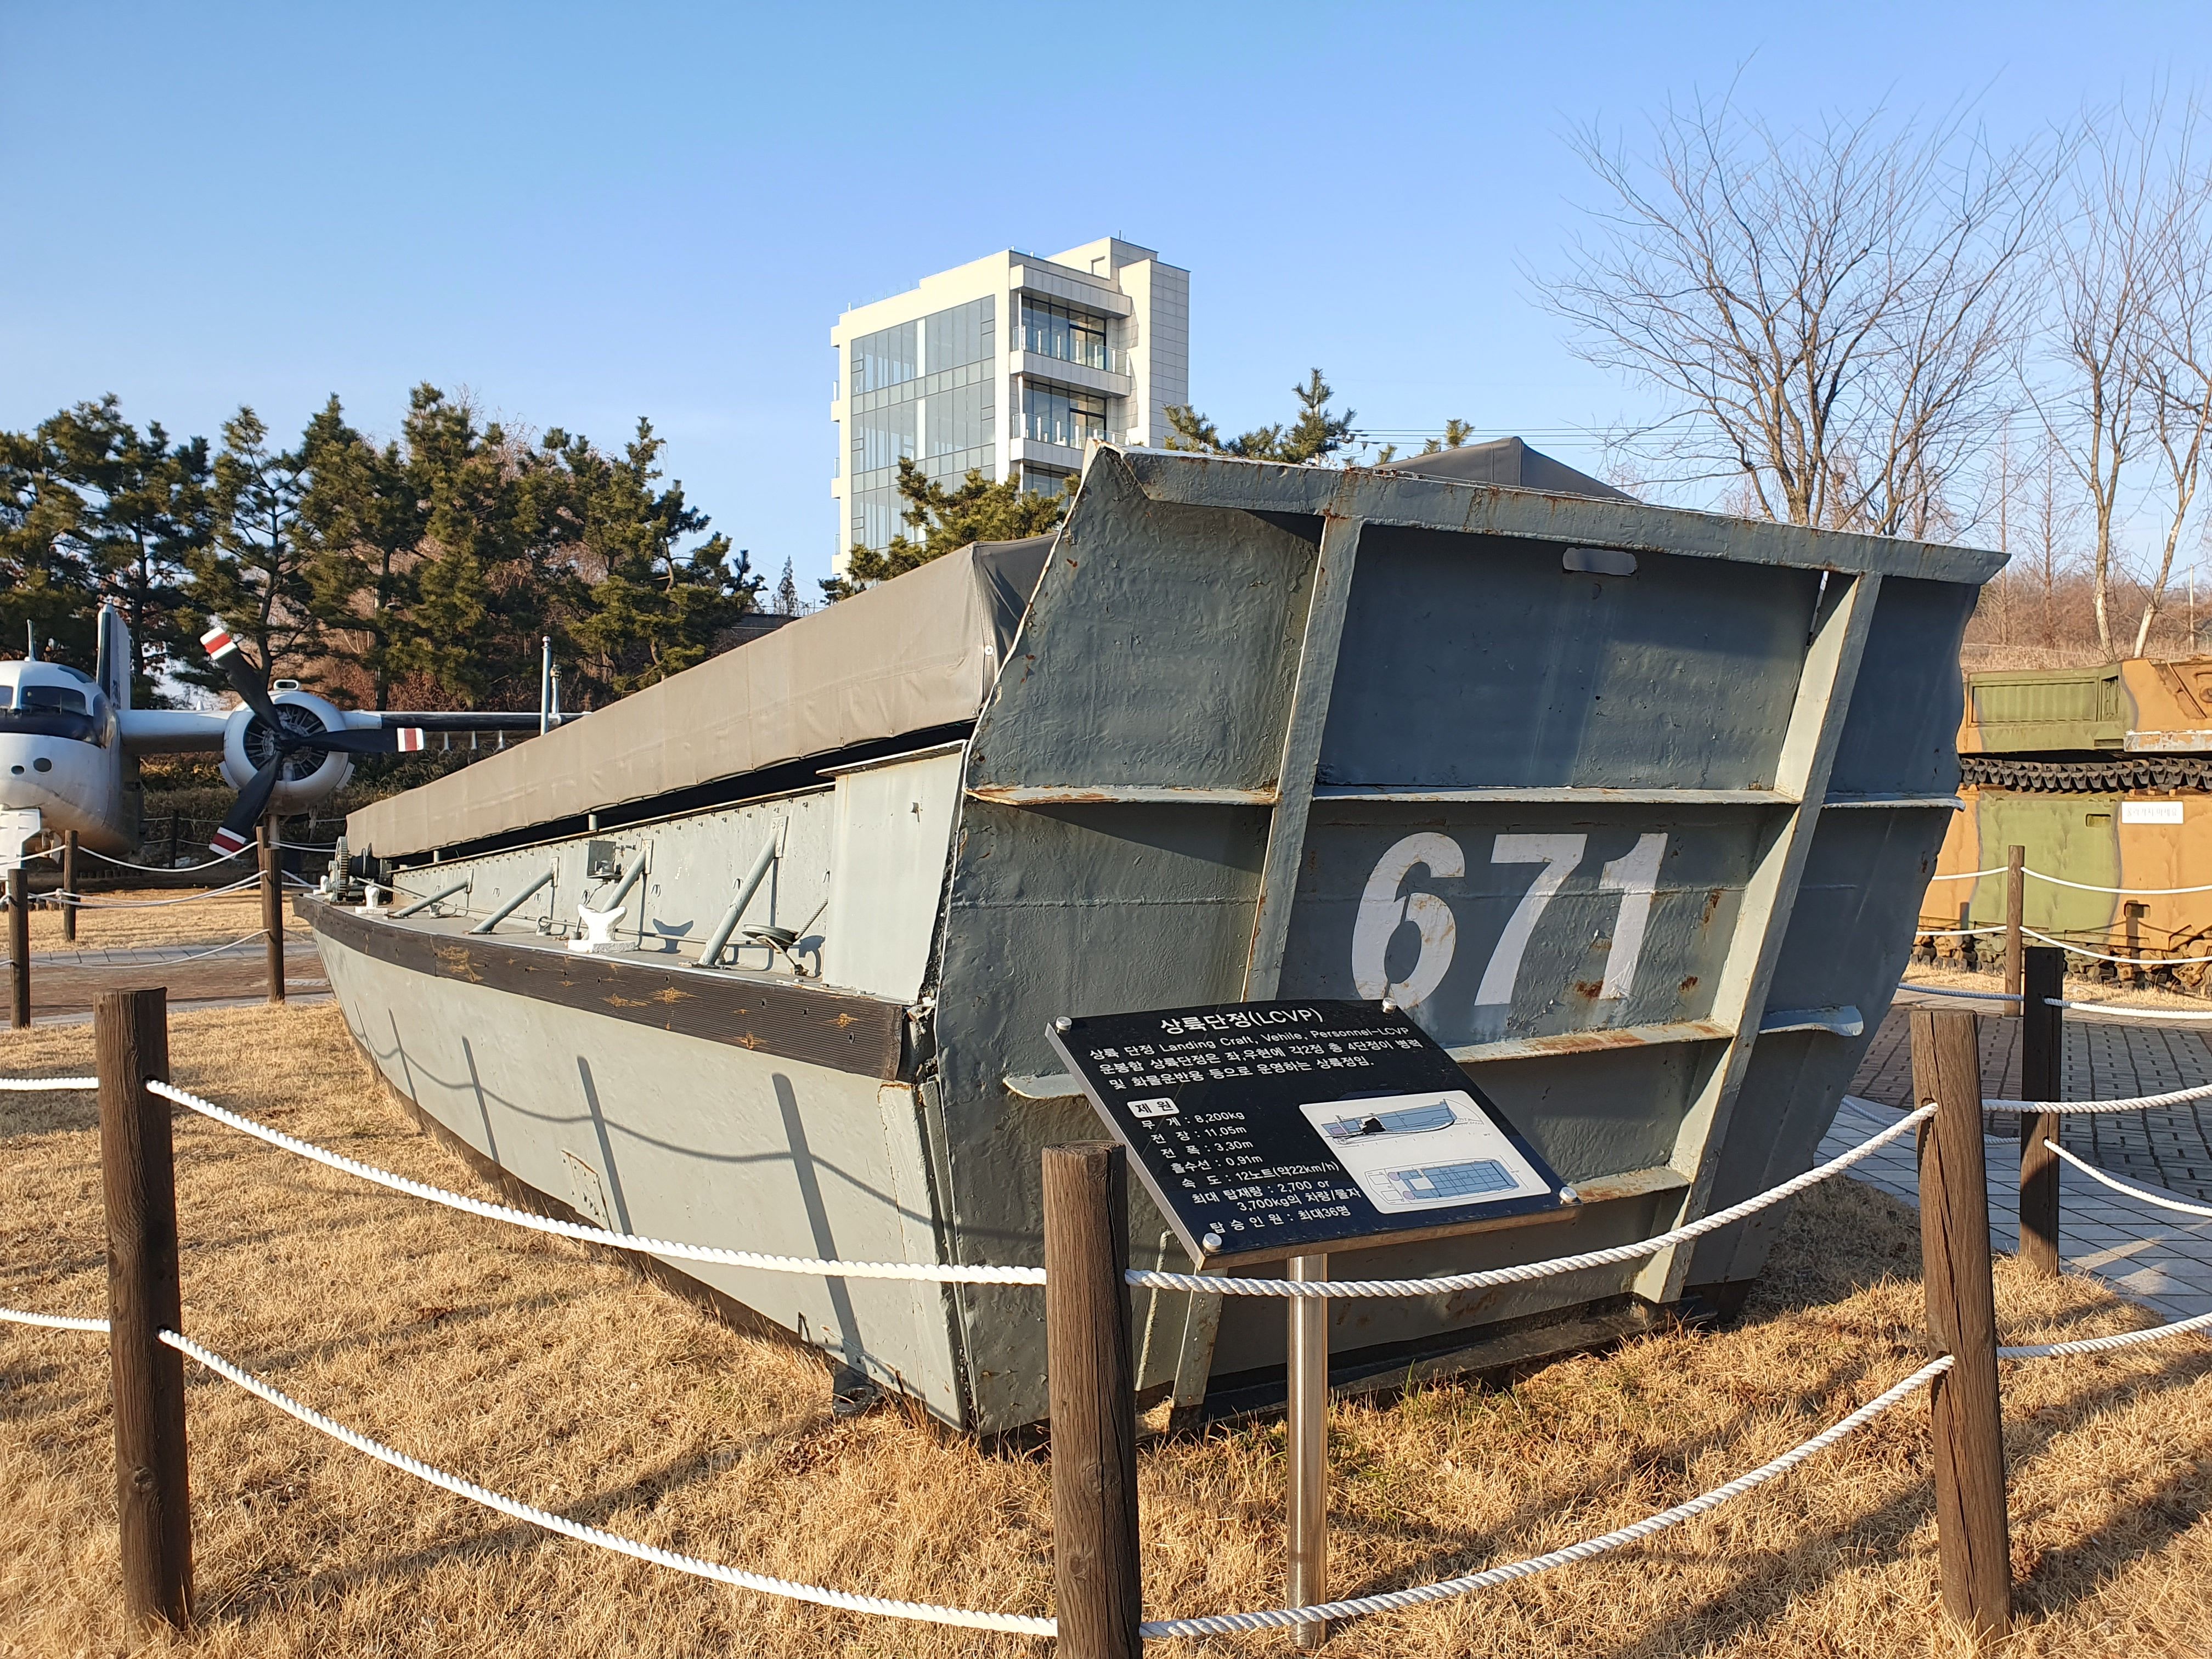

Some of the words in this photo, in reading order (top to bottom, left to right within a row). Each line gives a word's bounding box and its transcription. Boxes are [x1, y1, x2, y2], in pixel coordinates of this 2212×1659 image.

[1352, 831, 1668, 1010] 671
[1160, 1008, 1323, 1035] 상륙단정(LCVP)
[1090, 1048, 1119, 1060] 상륙
[1124, 1045, 1155, 1057] 단정
[1159, 1040, 1216, 1053] Landing
[1220, 1036, 1259, 1047] Craft,
[1261, 1031, 1308, 1042] Vehile,
[1310, 1027, 1409, 1040] Personnel-LCVP
[1099, 1060, 1144, 1075] 운봉함
[1150, 1053, 1221, 1070] 상륙단정은
[1288, 1043, 1324, 1055] 각2정
[1328, 1042, 1342, 1053] 총
[1348, 1040, 1394, 1051] 4단정이
[1395, 1039, 1423, 1049] 병력
[1109, 1079, 1126, 1090] 및
[1131, 1070, 1205, 1087] 화물운반용
[1209, 1066, 1254, 1080] 등으로
[1257, 1061, 1312, 1075] 운영하는
[1317, 1056, 1374, 1069] 상륙정임.
[1135, 1103, 1153, 1113] 제
[1156, 1101, 1173, 1111] 원
[1141, 1120, 1155, 1130] 무
[1194, 1111, 1245, 1124] 8,200kg
[1151, 1133, 1167, 1144] 전
[1175, 1131, 1190, 1141] 장
[1204, 1126, 1247, 1137] 11.05m
[1160, 1148, 1177, 1159] 전
[1186, 1145, 1200, 1155] 폭
[1214, 1141, 1254, 1152] 3.30m
[1225, 1155, 1263, 1167] 0.91m
[1182, 1177, 1196, 1189] 속
[1207, 1175, 1222, 1186] 도
[1235, 1160, 1340, 1181] 12노트(약22km/h)
[1192, 1190, 1221, 1204] 최대
[1224, 1185, 1264, 1201] 탑재량
[1277, 1181, 1312, 1194] 2,700
[1317, 1180, 1330, 1188] or
[1237, 1195, 1302, 1212] 3,700kg의
[1307, 1187, 1362, 1203] 차량/물자
[1210, 1221, 1226, 1234] 탑
[1230, 1219, 1245, 1231] 승
[1249, 1215, 1266, 1228] 인
[1269, 1212, 1285, 1226] 원
[1297, 1205, 1351, 1221] 최대36명
